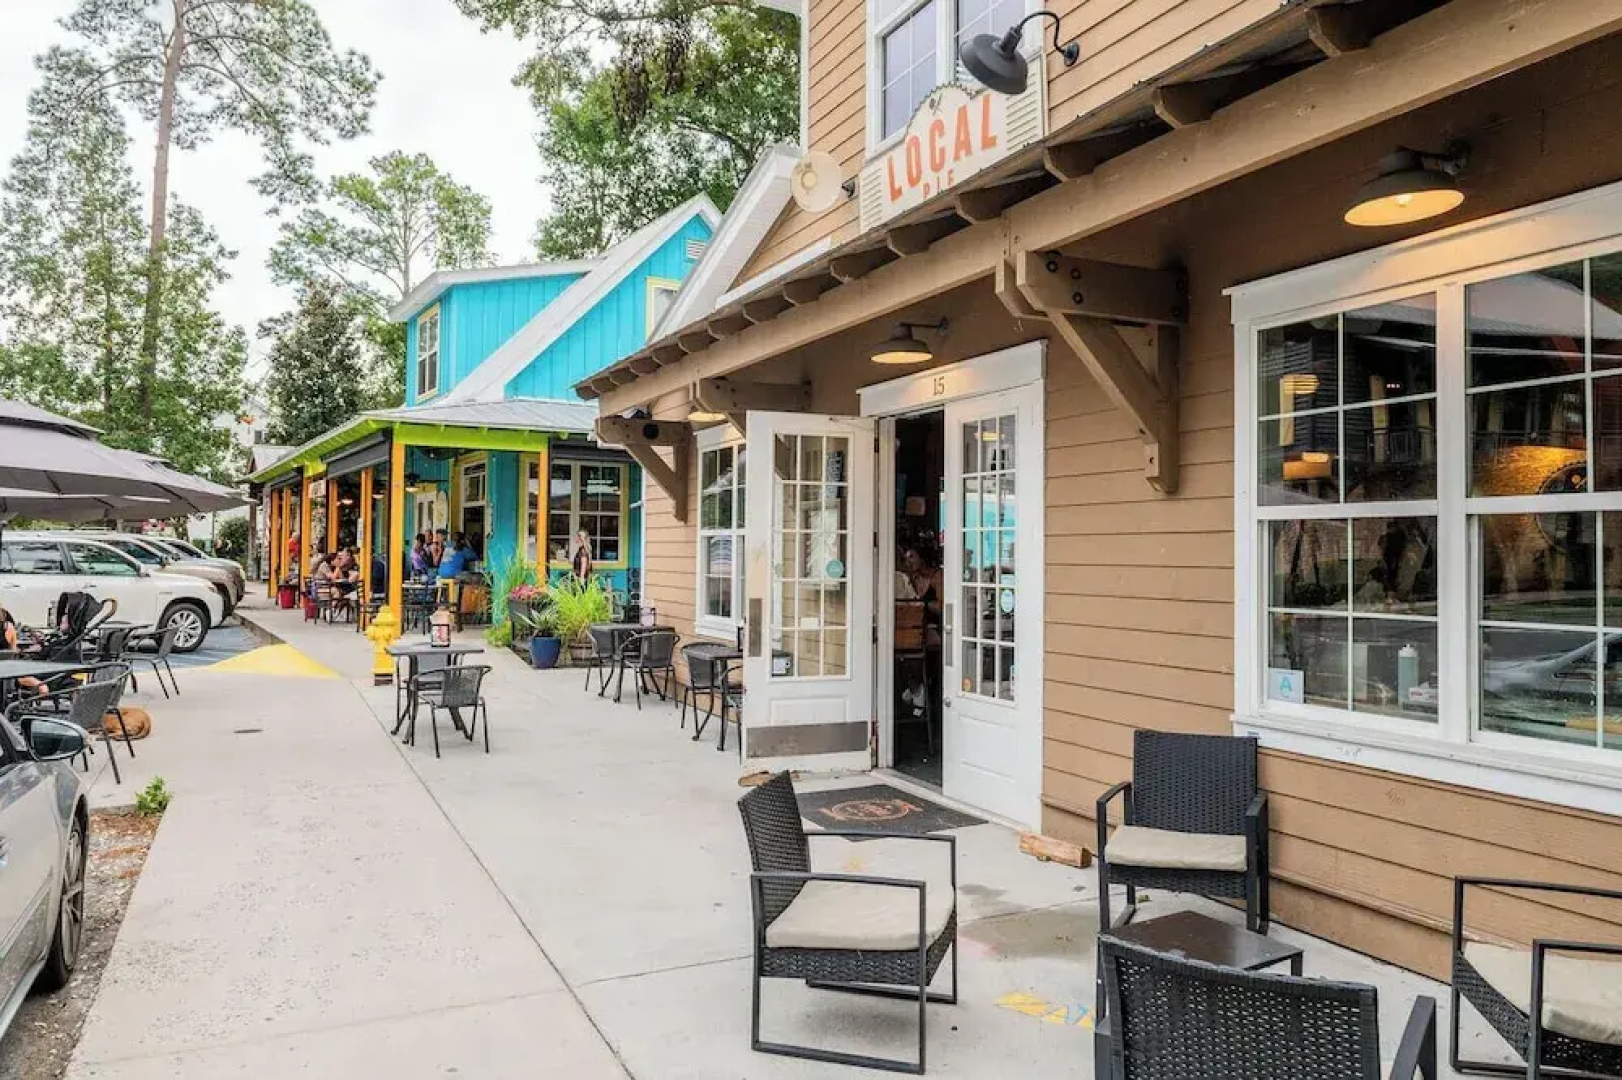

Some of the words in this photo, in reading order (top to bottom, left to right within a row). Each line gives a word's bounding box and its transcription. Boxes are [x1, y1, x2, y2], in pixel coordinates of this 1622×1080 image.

[887, 93, 998, 202] LOCAL
[922, 168, 954, 200] PIE
[932, 375, 945, 397] 15
[1279, 675, 1293, 692] A
